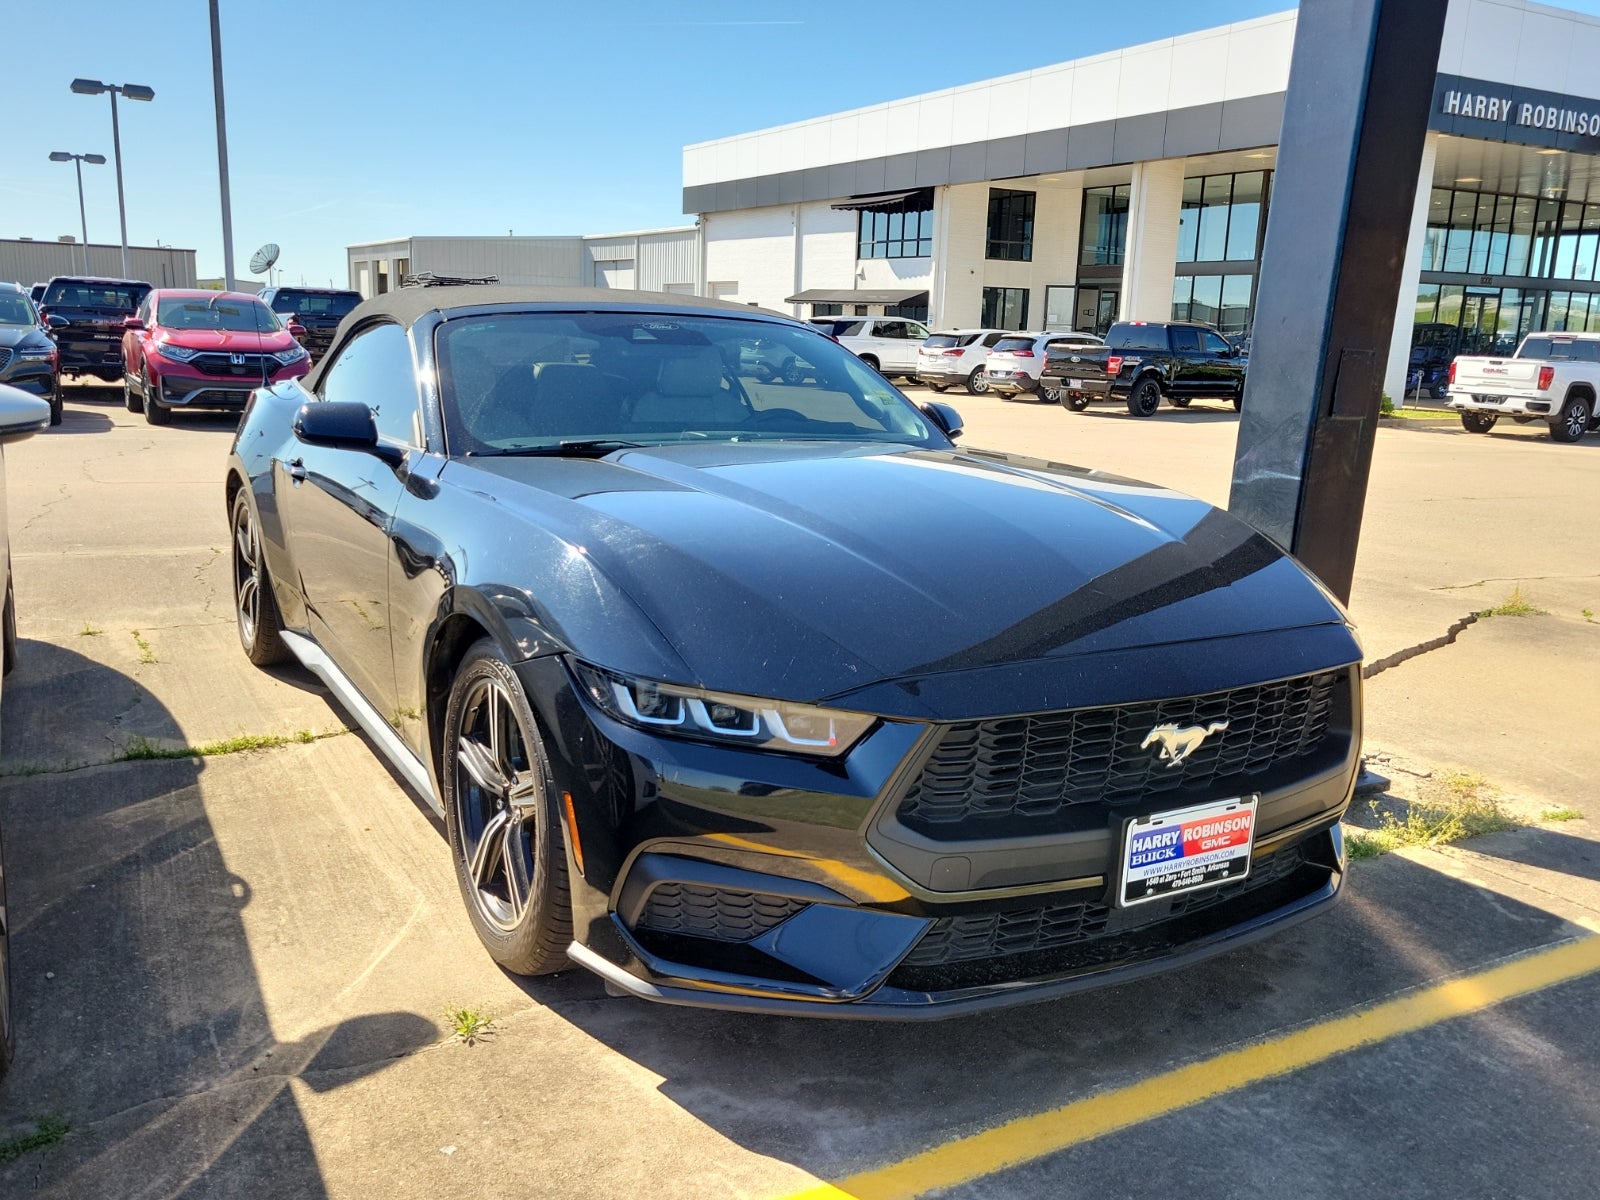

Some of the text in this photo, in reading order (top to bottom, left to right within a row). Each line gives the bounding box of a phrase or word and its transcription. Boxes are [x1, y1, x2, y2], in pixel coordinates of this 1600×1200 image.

[1445, 90, 1512, 122] HARRY
[1132, 815, 1251, 854] HARRY ROBINSON
[1201, 835, 1231, 851] GMC
[1131, 847, 1176, 866] BUICK
[1143, 849, 1236, 877] WWW.HARRYROBINSON.COM
[1180, 870, 1192, 880] Fort
[1207, 861, 1230, 873] Arkansas
